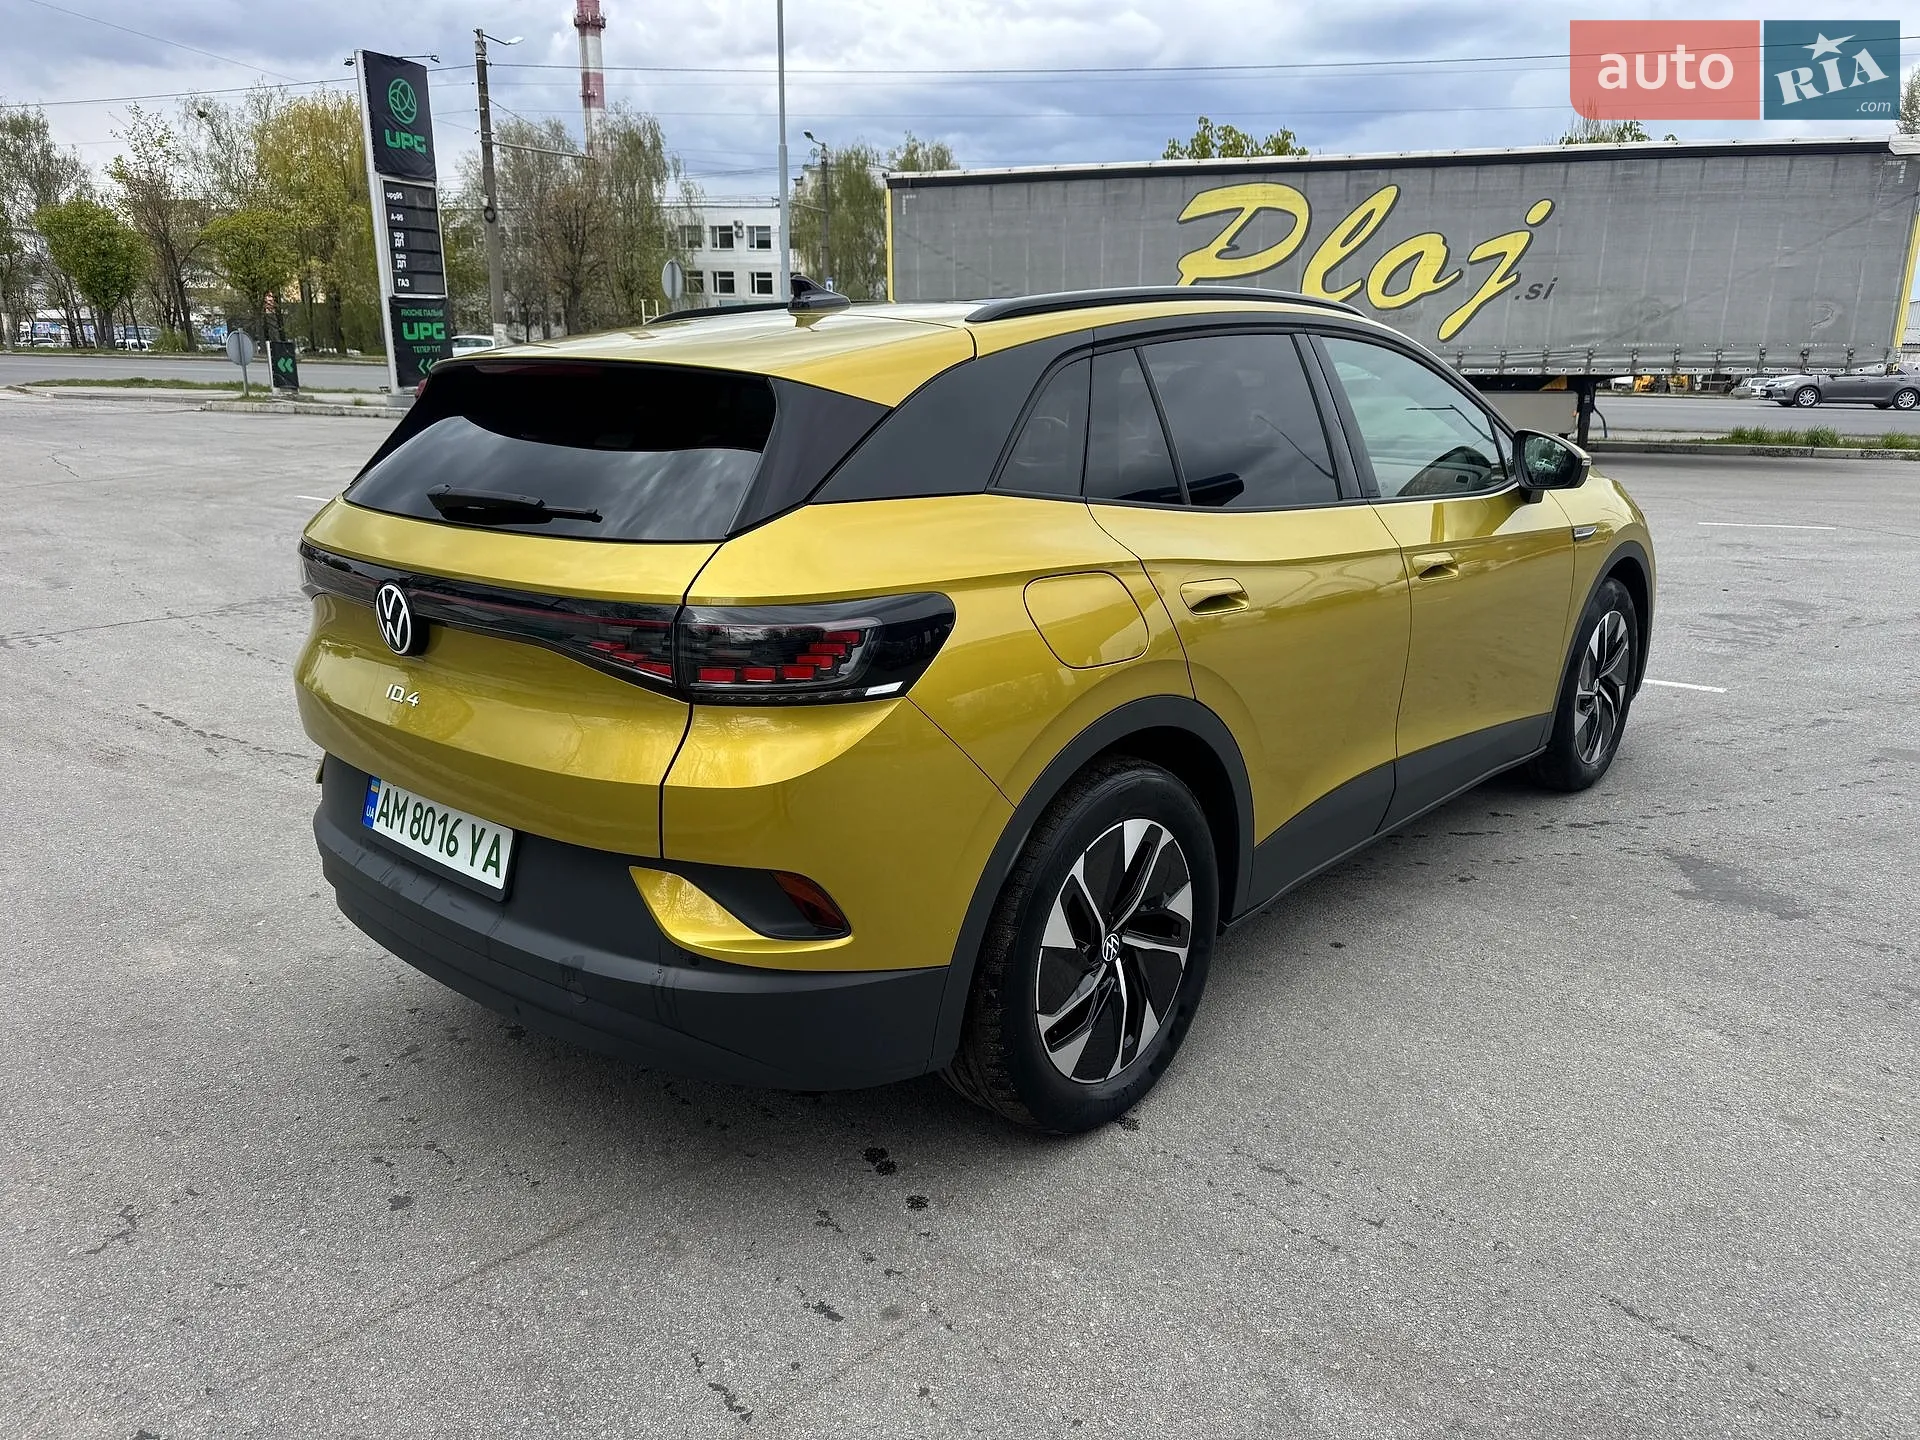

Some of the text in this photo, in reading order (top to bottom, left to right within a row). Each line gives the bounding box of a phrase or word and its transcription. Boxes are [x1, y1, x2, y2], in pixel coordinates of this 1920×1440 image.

[385, 129, 427, 153] UPG
[397, 278, 410, 287] ГАЗ
[1514, 277, 1558, 301] .si
[402, 322, 446, 340] UPG
[366, 804, 375, 821] UA
[376, 787, 501, 878] AM 8016 YA
